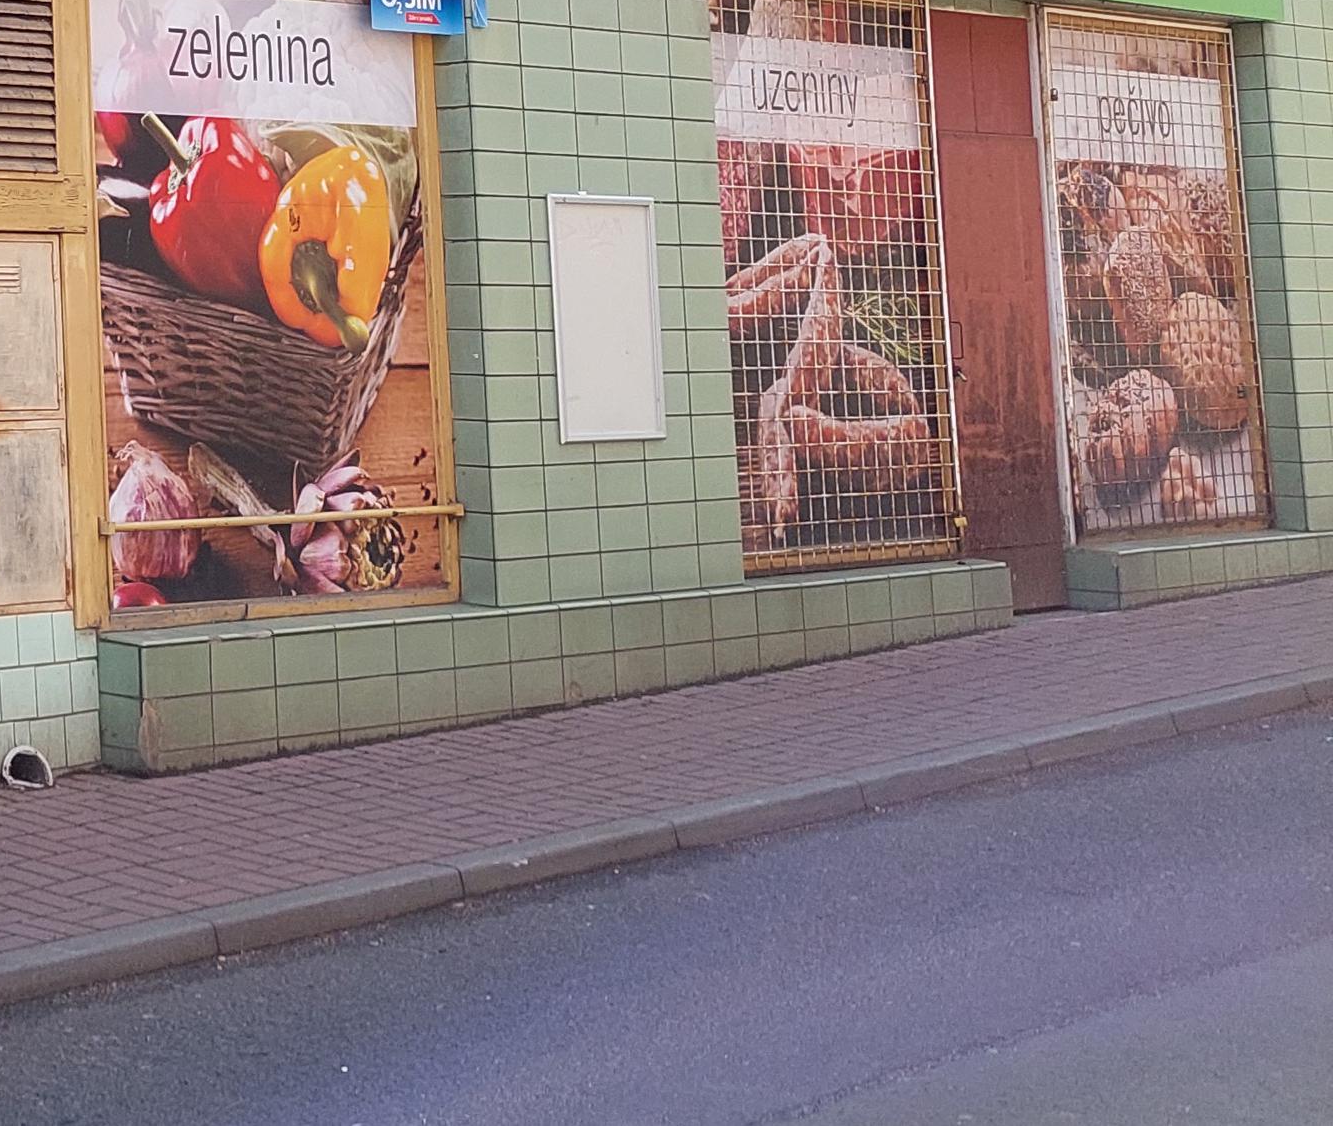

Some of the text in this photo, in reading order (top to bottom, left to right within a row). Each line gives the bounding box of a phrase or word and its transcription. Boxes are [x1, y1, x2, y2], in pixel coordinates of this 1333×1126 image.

[167, 15, 336, 87] zelenina
[750, 59, 859, 128] uzeniny
[1098, 84, 1171, 143] pečivo
